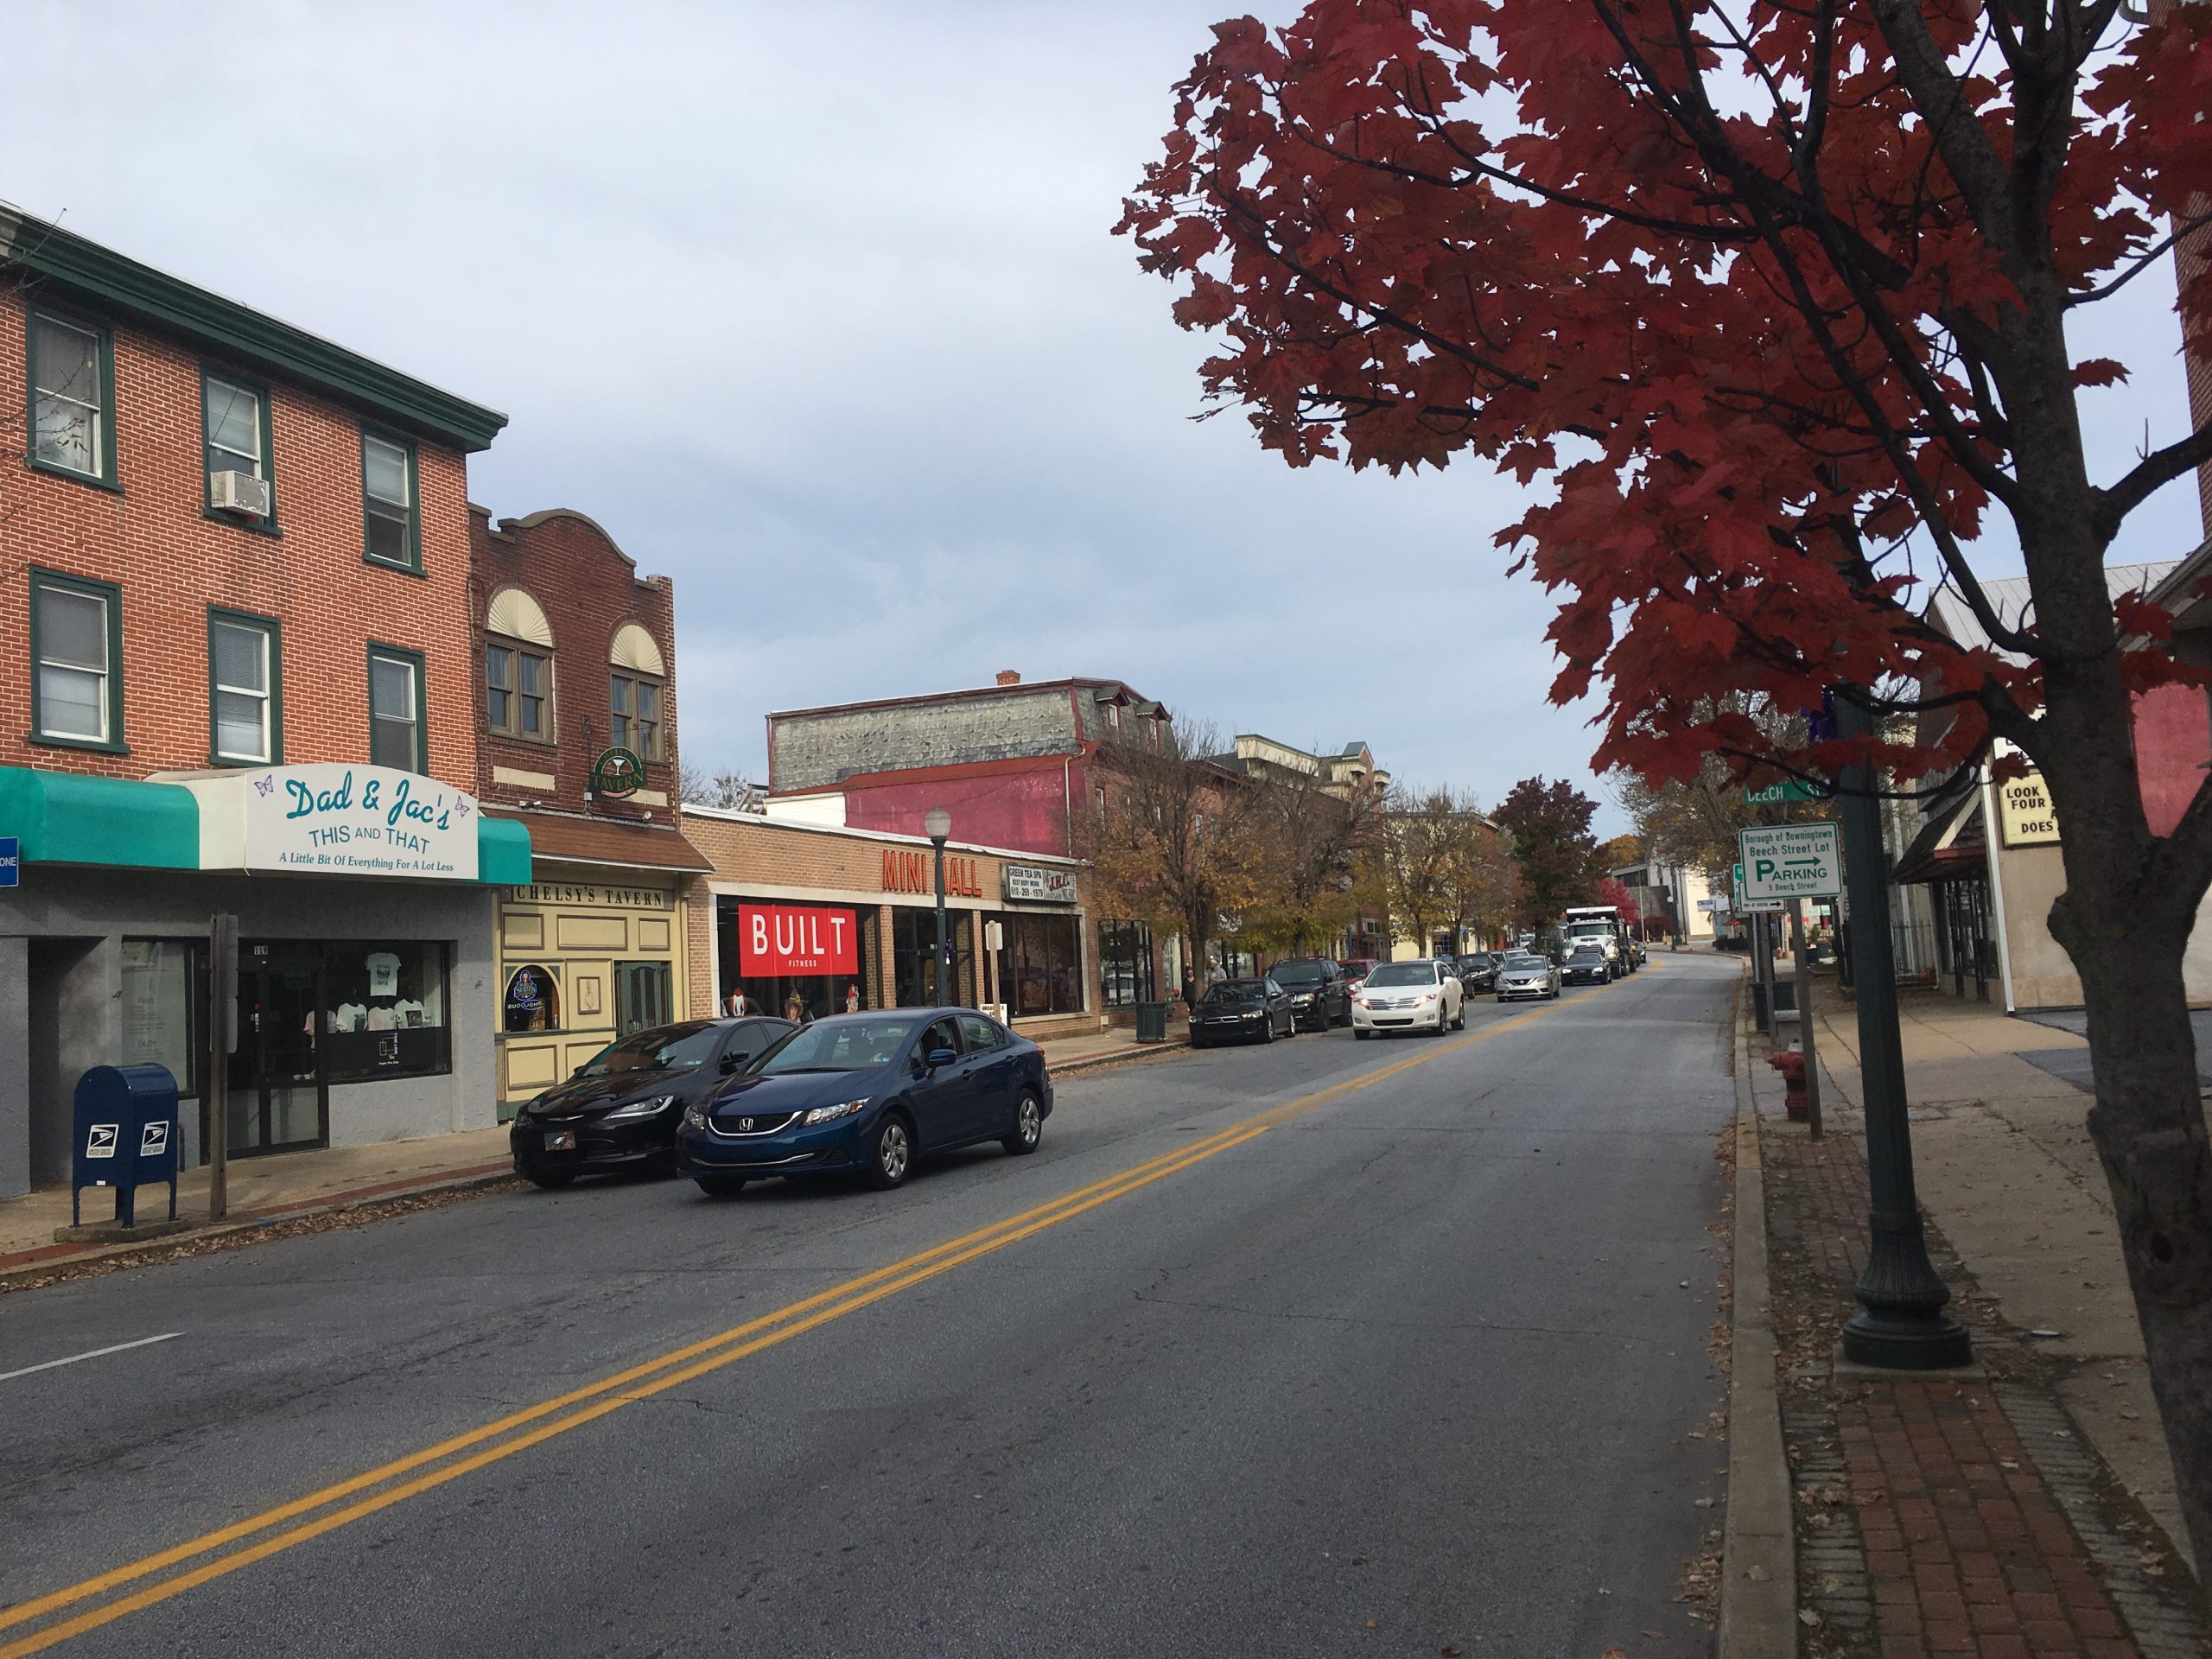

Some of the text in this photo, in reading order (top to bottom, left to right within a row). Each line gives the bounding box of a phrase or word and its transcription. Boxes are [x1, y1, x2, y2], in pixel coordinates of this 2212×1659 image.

[590, 771, 644, 791] TAVERN
[286, 770, 449, 830] Dad & Jac's
[2006, 786, 2040, 798] LOOK
[2012, 798, 2046, 810] FOUR
[2021, 822, 2054, 833] DOES
[308, 825, 430, 854] THIS AND THAT
[1745, 830, 1833, 844] Borough of Downingtown
[1750, 842, 1830, 857] Beech Street Lot
[279, 851, 454, 871] A Little Bit Of Everything For A Lot Less
[883, 849, 927, 893] MINI
[1009, 868, 1042, 879] GREEN TEA SPA
[1755, 859, 1827, 882] PARKING
[1797, 881, 1817, 890] Street
[517, 885, 663, 906] CHELSY'S TAVERN
[753, 914, 846, 956] BUILT
[788, 959, 818, 968] FITNESS
